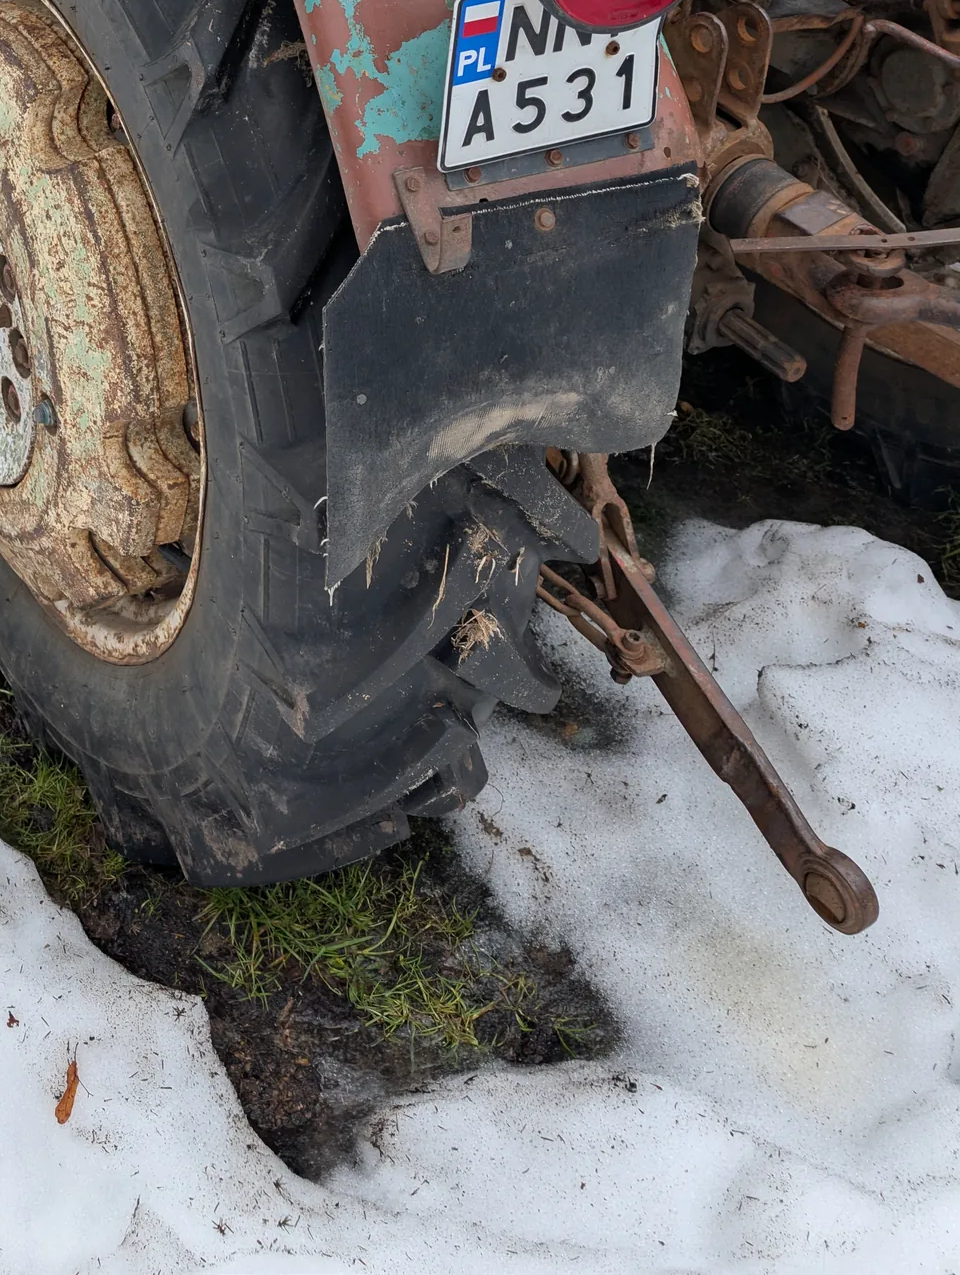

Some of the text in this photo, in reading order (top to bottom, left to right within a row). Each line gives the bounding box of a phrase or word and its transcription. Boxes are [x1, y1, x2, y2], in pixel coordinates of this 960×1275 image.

[457, 46, 492, 77] PL
[505, 4, 619, 62] NN
[461, 53, 636, 148] A531
